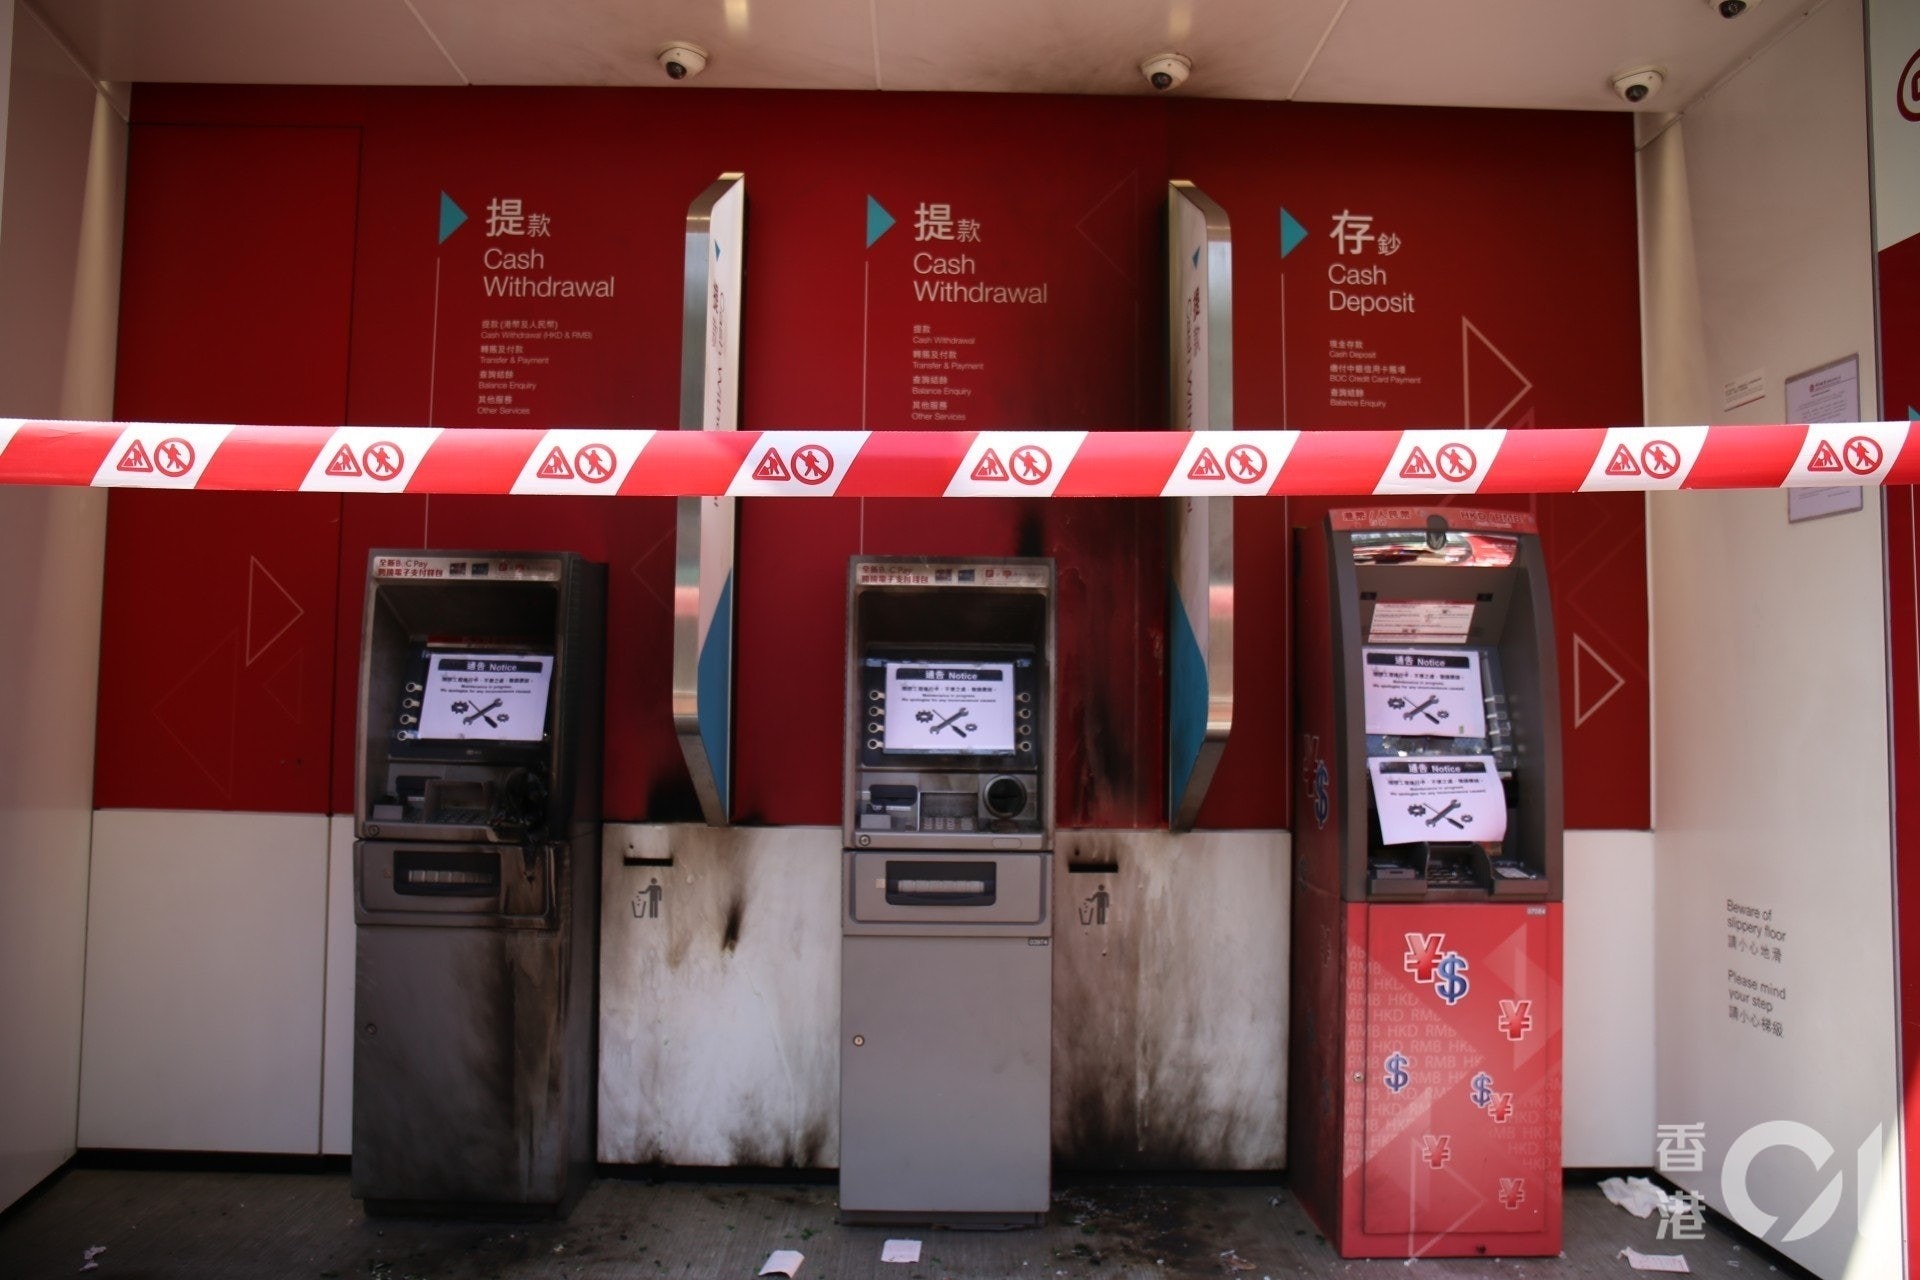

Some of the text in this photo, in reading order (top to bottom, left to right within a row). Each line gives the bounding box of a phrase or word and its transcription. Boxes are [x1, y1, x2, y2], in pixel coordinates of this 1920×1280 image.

[486, 198, 551, 237] 提款
[914, 202, 981, 243] 提款
[1329, 209, 1402, 256] 存鈔
[484, 248, 544, 269] Cash
[913, 252, 975, 274] Cash
[1328, 263, 1387, 285] Cash
[483, 276, 614, 297] Withdrawal
[914, 280, 1048, 304] Withdrawal
[1329, 290, 1415, 316] Deposit
[489, 663, 518, 672] Notice
[1417, 658, 1446, 667] Notice
[948, 672, 978, 681] Notice
[1431, 765, 1461, 773] Notice
[1726, 899, 1772, 921] Beware of
[1726, 917, 1787, 942] slippery floor
[1727, 934, 1782, 963] 請小心地滑
[1727, 969, 1786, 1000] Please mind
[1728, 988, 1773, 1014] your step
